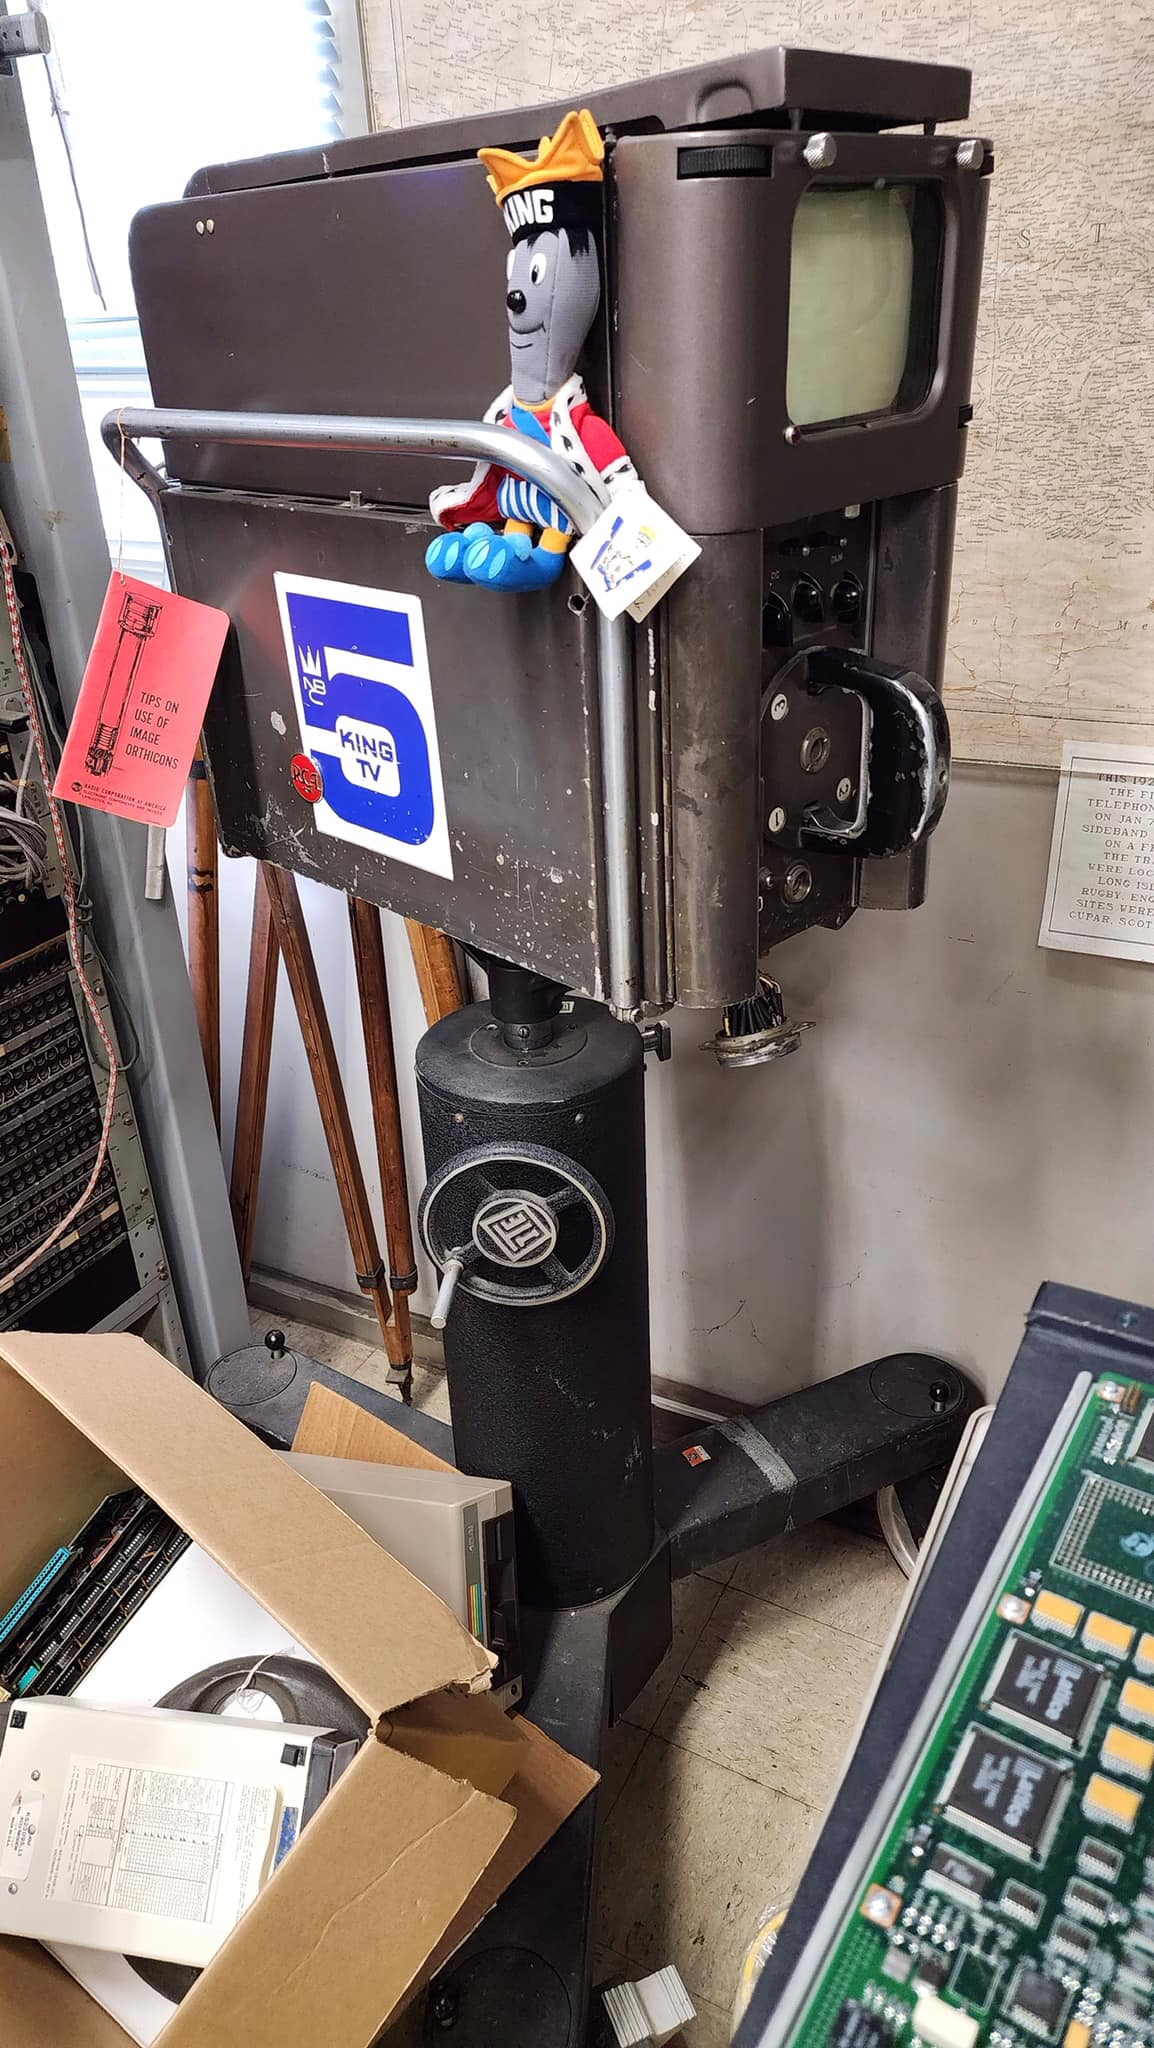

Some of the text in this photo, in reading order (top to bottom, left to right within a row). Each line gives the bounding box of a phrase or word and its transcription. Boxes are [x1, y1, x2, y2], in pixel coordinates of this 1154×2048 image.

[141, 692, 180, 714] TIPS ON
[134, 708, 170, 728] USE OF
[130, 726, 160, 746] IMAGE
[339, 729, 394, 763] KING
[126, 744, 179, 770] ORTHICONS
[356, 758, 381, 782] TV
[1097, 773, 1128, 784] THIS
[1109, 787, 1136, 798] THE
[1095, 812, 1112, 821] ON
[1120, 815, 1143, 824] JAN
[1082, 824, 1148, 838] SIDEBAND
[1104, 840, 1122, 848] ON
[1127, 842, 1134, 850] A
[1104, 852, 1128, 862] THE
[1088, 863, 1122, 874] WERE
[1098, 876, 1130, 888] LONG
[1076, 899, 1154, 916] SITES WERE
